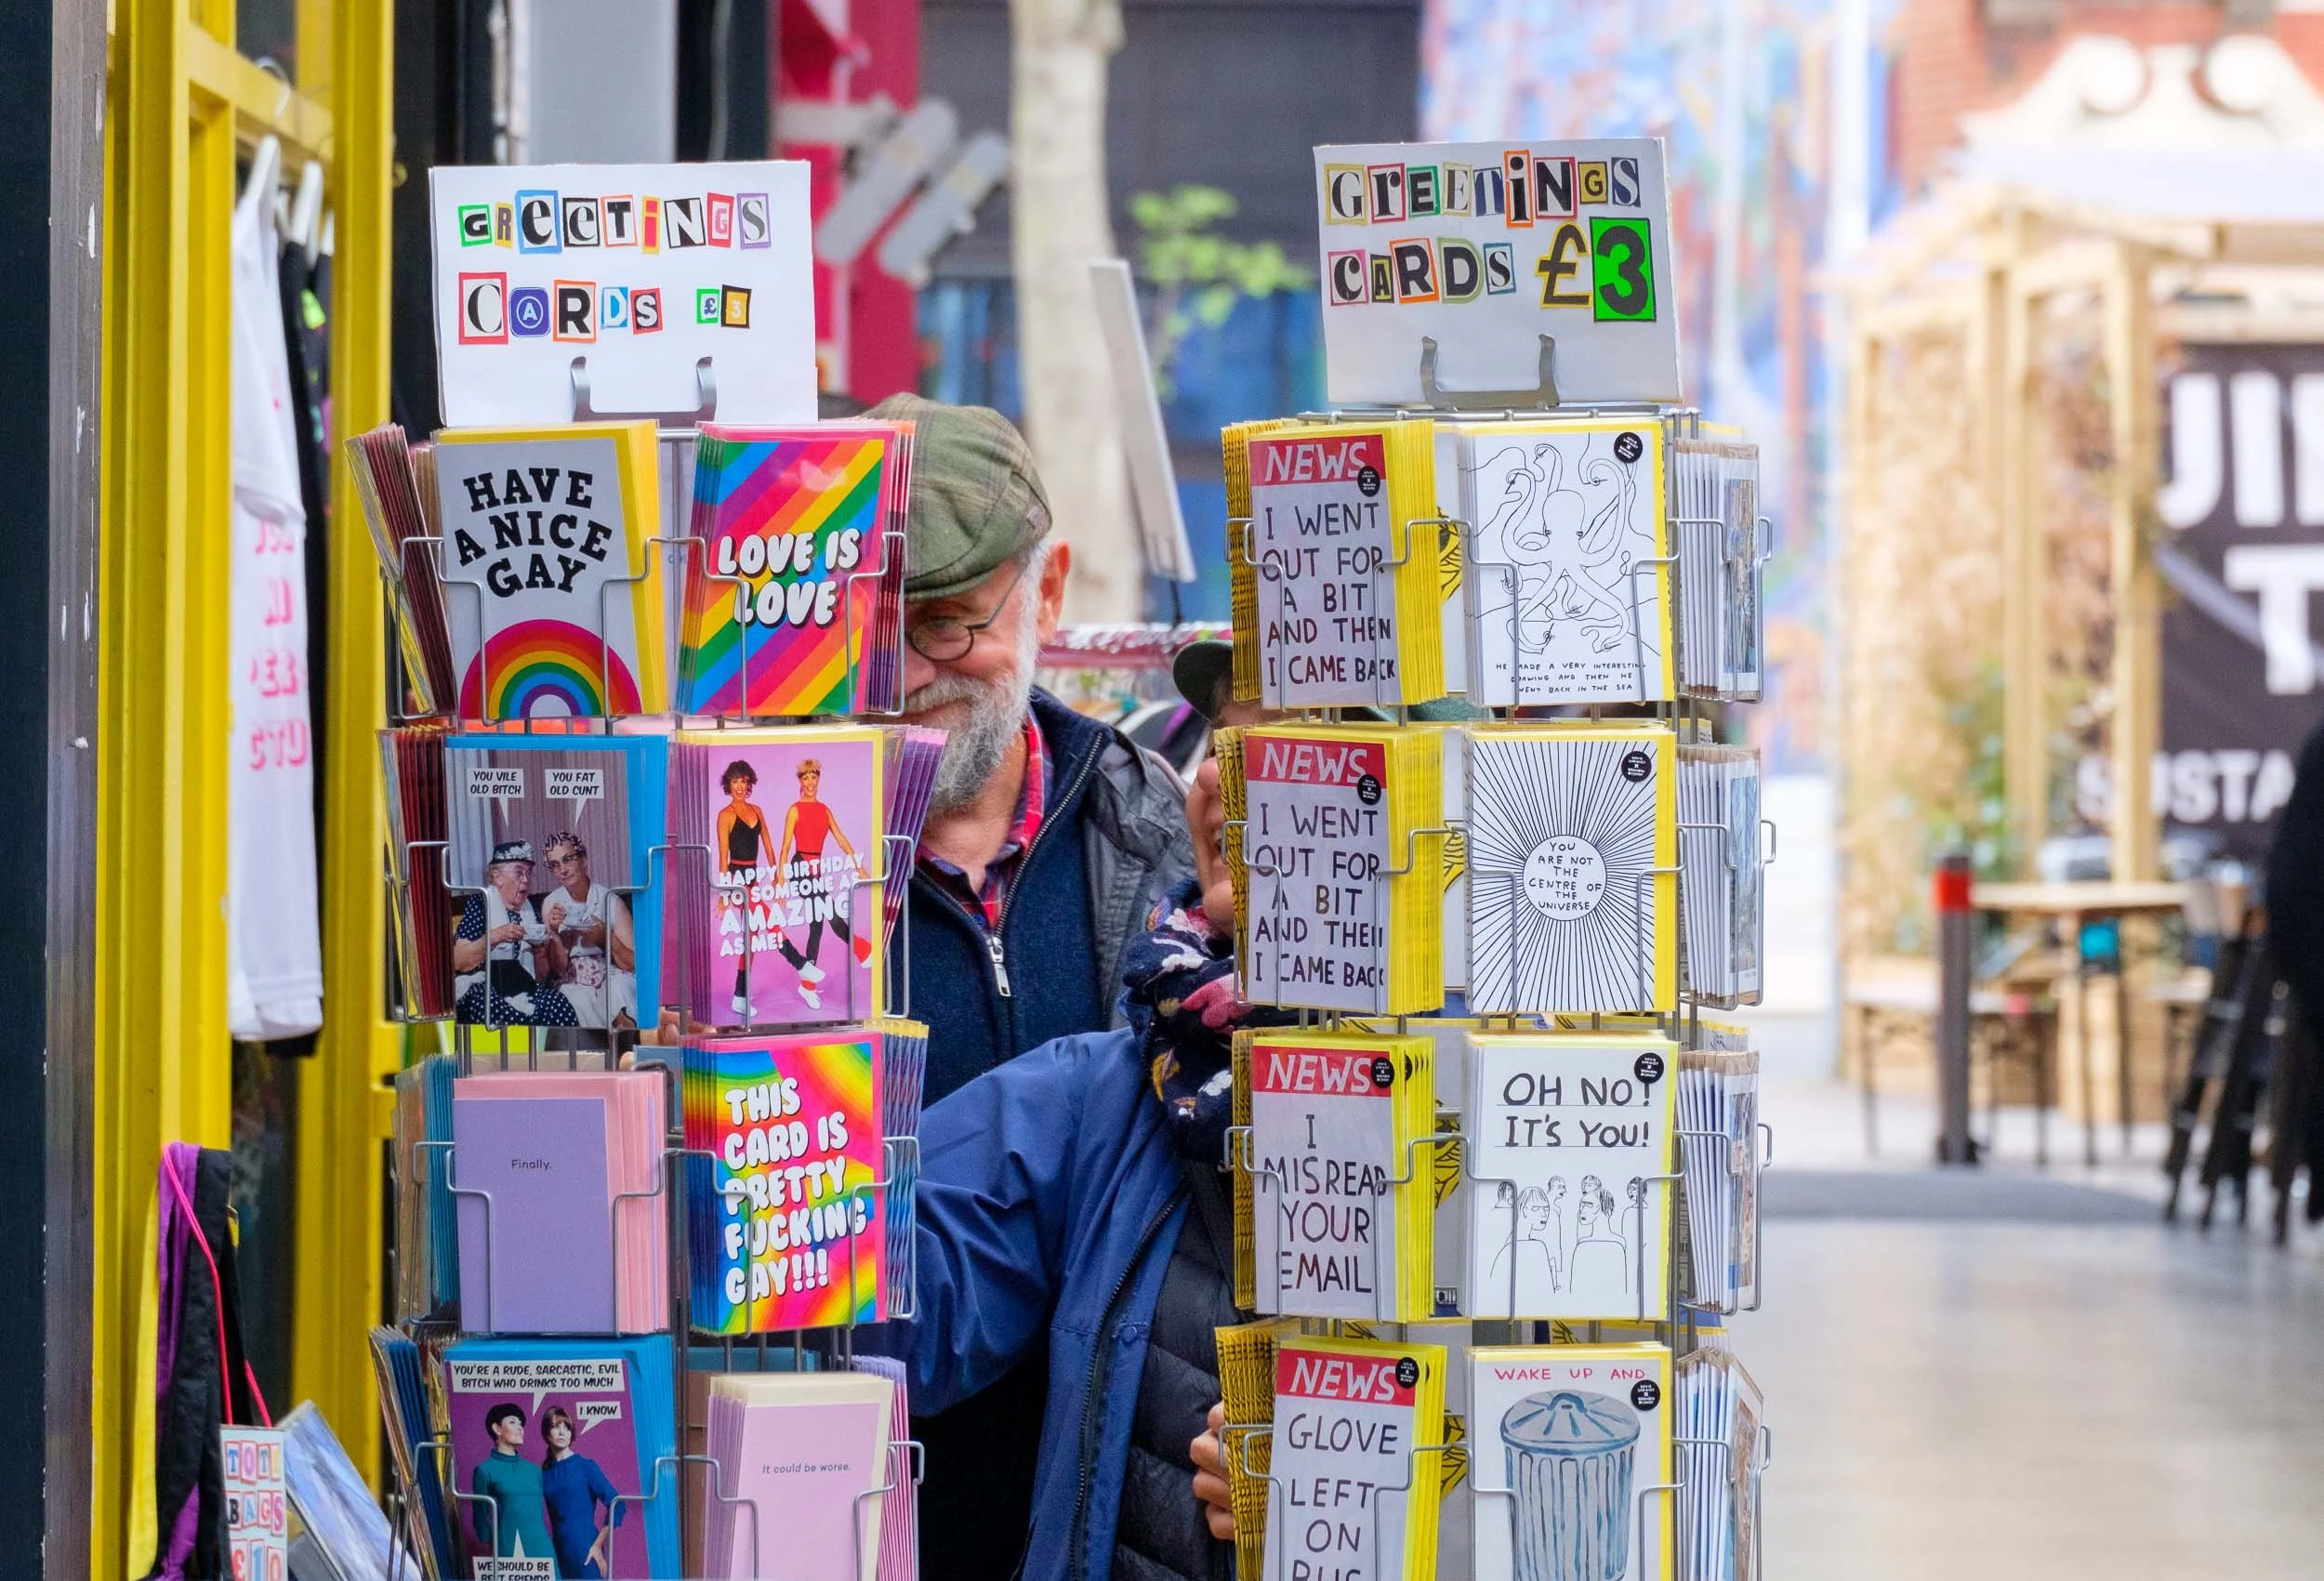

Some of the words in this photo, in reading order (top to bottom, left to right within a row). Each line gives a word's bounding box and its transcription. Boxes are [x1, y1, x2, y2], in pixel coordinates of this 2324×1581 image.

[1333, 243, 1512, 301] CARDS
[1537, 222, 1648, 315] £3
[467, 283, 658, 336] CARDS
[701, 294, 746, 323] £3
[1264, 441, 1367, 482] NEWS
[2156, 370, 2324, 530] JI
[463, 467, 594, 512] HAVE
[452, 527, 485, 566] A
[488, 510, 614, 563] NICE
[1265, 507, 1274, 540] I
[1294, 502, 1380, 536] WENT
[718, 532, 817, 576] LOVE
[825, 528, 860, 571] IS
[1261, 547, 1320, 581] OUT
[1337, 546, 1385, 575] FOR
[486, 552, 588, 599] GAY
[734, 580, 838, 627] LOVE
[1283, 586, 1298, 613] A
[1323, 583, 1368, 613] BIT
[1267, 618, 1317, 648] AND
[1332, 617, 1392, 643] THEN
[1268, 657, 1277, 687] I
[1288, 655, 1347, 685] CAME
[1354, 656, 1396, 682] BACK
[473, 771, 494, 782] YOU
[495, 771, 518, 782] VILE
[552, 772, 573, 783] YOU
[575, 772, 596, 783] FAT
[1261, 742, 1367, 783] NEWS
[469, 784, 489, 795] OLD
[492, 784, 522, 795] BITCH
[549, 785, 570, 796] OLD
[572, 785, 600, 796] CUNT
[1260, 802, 1269, 836] I
[1290, 803, 1378, 838] WENT
[1254, 844, 1315, 878] OUT
[1332, 850, 1380, 882] FOR
[1538, 854, 1563, 864] ARE
[1570, 856, 1593, 865] NOT
[1550, 841, 1576, 851] YOU
[719, 865, 777, 888] HAPPY
[783, 852, 865, 879] BIRTHDAY
[1528, 877, 1577, 891] CENTRE
[1586, 883, 1602, 892] OF
[1552, 866, 1579, 877] THE
[720, 889, 746, 907] TO
[750, 876, 834, 903] SOMEONE
[838, 871, 861, 890] AS
[1271, 885, 1288, 910] A
[1316, 884, 1363, 916] BIT
[1538, 901, 1590, 911] UNIVERSE
[1554, 890, 1578, 900] THE
[720, 890, 850, 935] AMAZING
[1255, 916, 1308, 943] AND
[720, 938, 746, 956] AS
[750, 931, 784, 953] ME!
[1255, 951, 1262, 982] I
[1265, 1053, 1371, 1093] NEWS
[1502, 1073, 1562, 1106] OH
[724, 1077, 801, 1126] THIS
[724, 1121, 809, 1171] CARD
[817, 1112, 849, 1153] IS
[1305, 1113, 1316, 1149] I
[1505, 1113, 1561, 1148] IT'S
[1579, 1121, 1650, 1148] YOU!
[511, 1159, 552, 1171] Finally.
[1261, 1155, 1387, 1197] MISREAD
[724, 1155, 846, 1216] PRETTY
[724, 1196, 866, 1260] FUCKING
[1281, 1200, 1370, 1244] YOUR
[724, 1247, 829, 1306] GAY!!!
[1280, 1251, 1372, 1294] EMAIL
[454, 1364, 489, 1376] YOU'RE
[492, 1365, 499, 1375] A
[503, 1365, 533, 1377] RUDE,
[598, 1364, 620, 1374] EVIL
[461, 1378, 491, 1388] BITCH
[493, 1378, 517, 1388] WHO
[520, 1378, 558, 1388] DRINKS
[560, 1377, 581, 1388] TOO
[583, 1377, 614, 1388] MUCH
[1288, 1357, 1396, 1402] NEWS
[1494, 1367, 1552, 1381] WAKE
[1569, 1367, 1593, 1380] UP
[1610, 1367, 1645, 1380] AND
[579, 1406, 583, 1416] I
[586, 1405, 617, 1416] KNOW
[1288, 1413, 1397, 1455] GLOVE
[762, 1465, 771, 1474] It
[773, 1462, 802, 1474] could
[804, 1463, 816, 1473] be
[819, 1464, 852, 1472] worse.
[1289, 1478, 1375, 1509] LEFT
[229, 1495, 283, 1532] BAGS
[1305, 1519, 1361, 1553] ON
[477, 1561, 493, 1571] WE
[496, 1561, 534, 1572] SHOULD
[536, 1561, 550, 1571] BE
